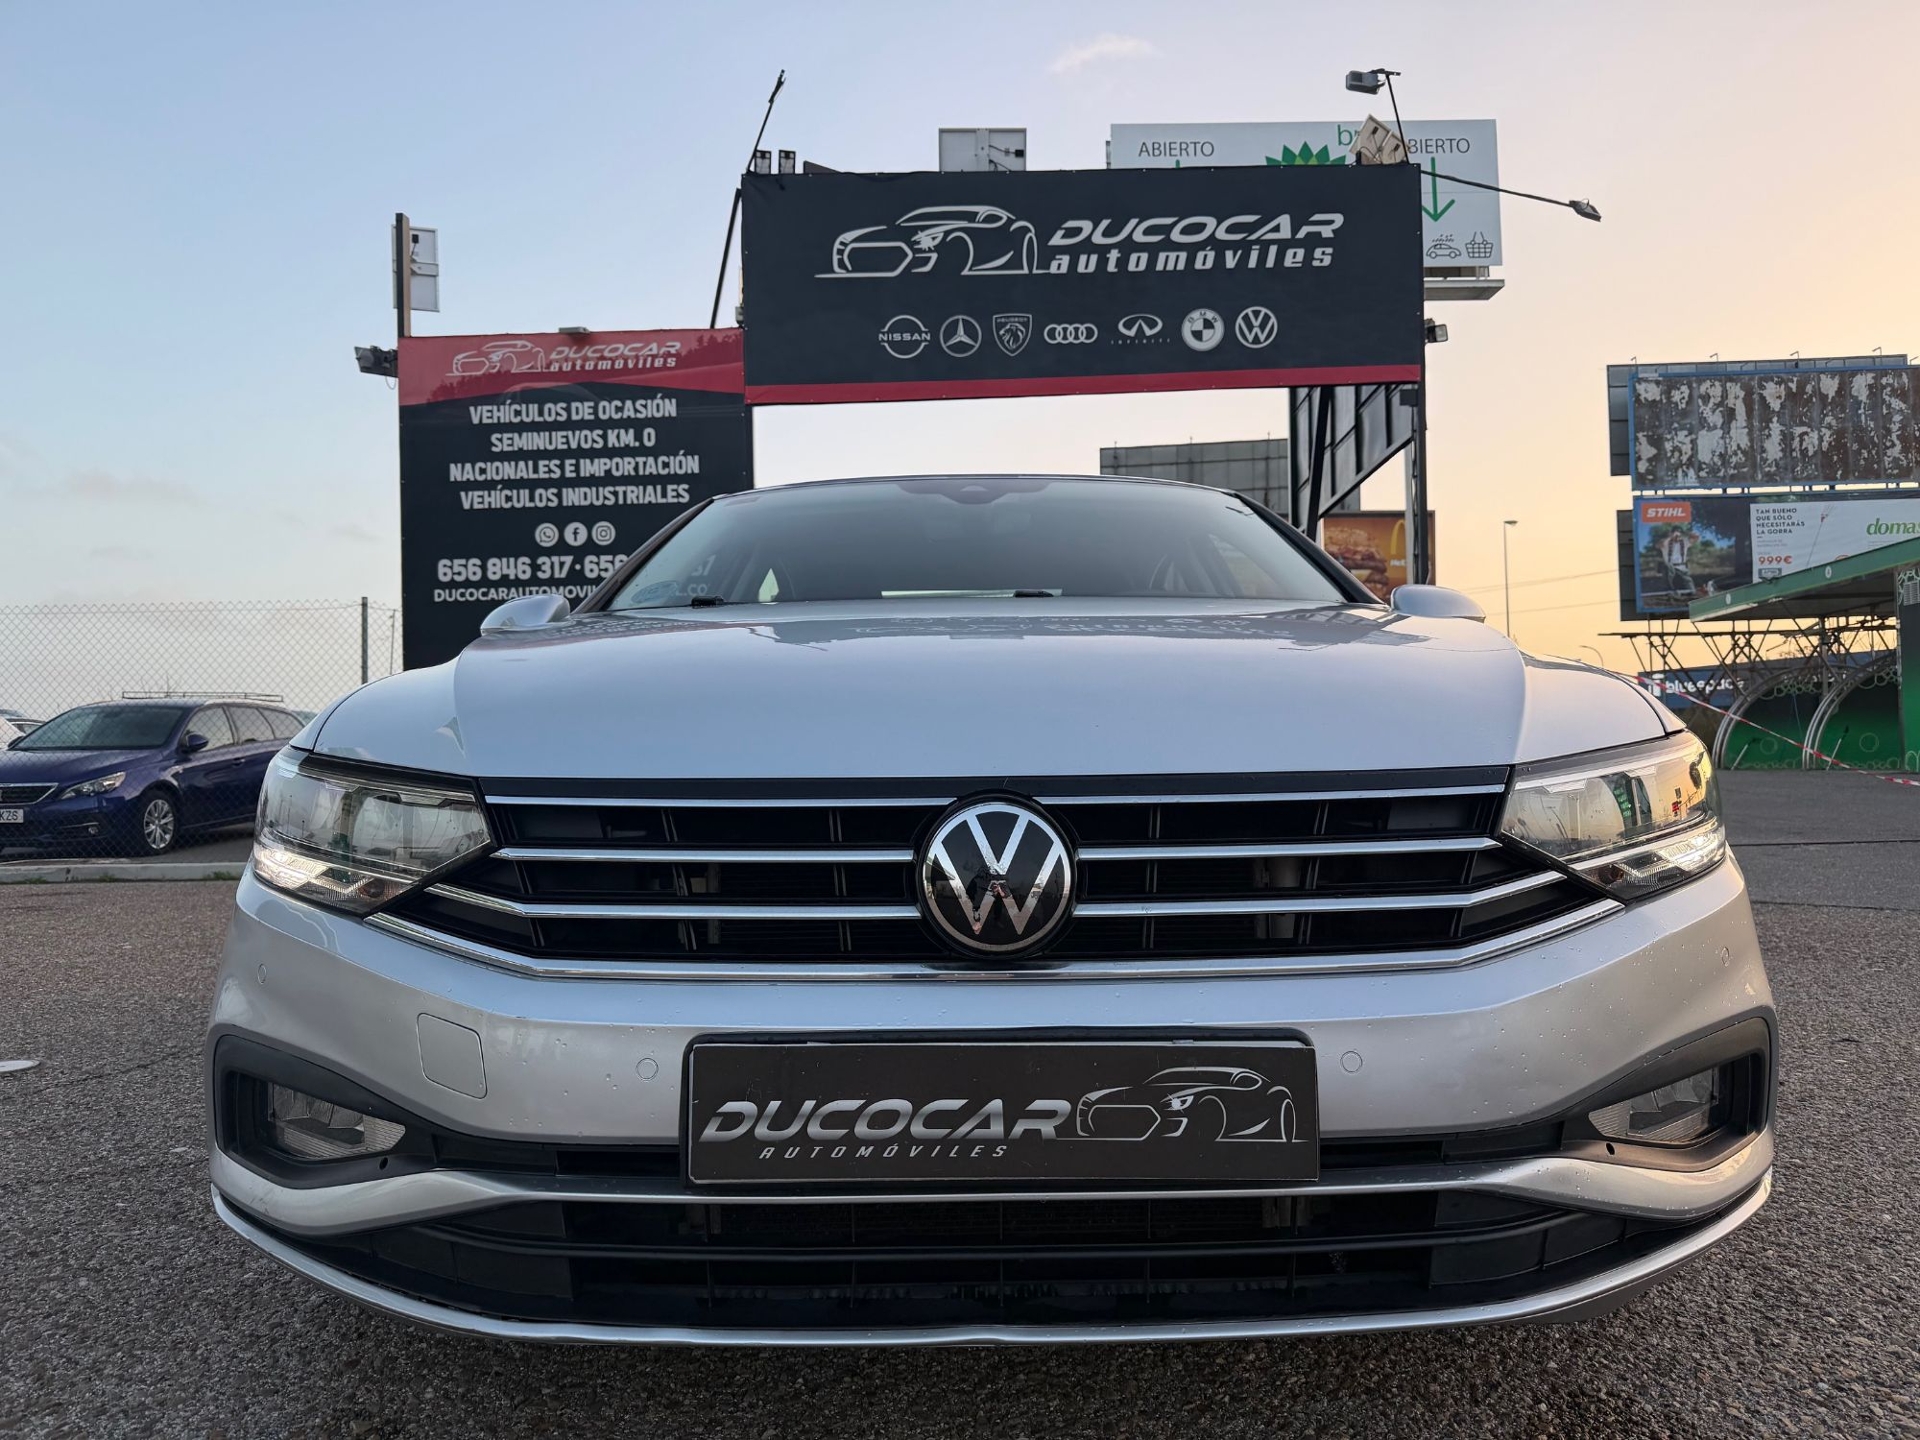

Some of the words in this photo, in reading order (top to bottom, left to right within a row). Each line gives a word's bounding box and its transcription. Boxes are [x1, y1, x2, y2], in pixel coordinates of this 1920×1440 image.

[1138, 141, 1215, 158] ABIERTO
[1407, 138, 1470, 154] BIERTO
[1047, 213, 1344, 246] DUCOCAR
[1049, 245, 1334, 274] automóviles
[878, 332, 931, 342] NISSAN
[549, 342, 681, 359] DUCOCAR
[469, 400, 567, 425] VEHÍCULOS
[571, 402, 595, 421] DE
[598, 393, 677, 420] OCASIÓN
[491, 429, 604, 452] SEMINUEVOS
[607, 428, 640, 448] KM.
[449, 459, 561, 482] NACIONALES
[565, 459, 577, 478] E
[580, 450, 700, 477] IMPORTACIÓN
[460, 484, 559, 510] VEHÍCULOS
[562, 484, 691, 507] INDUSTRIALES
[1646, 507, 1686, 518] STIHL
[437, 558, 483, 582] 656
[487, 556, 532, 581] 846
[1759, 555, 1793, 565] 999€
[699, 1098, 1071, 1142] DUCOCAR
[759, 1143, 1009, 1159] AUTOMÓVILES
